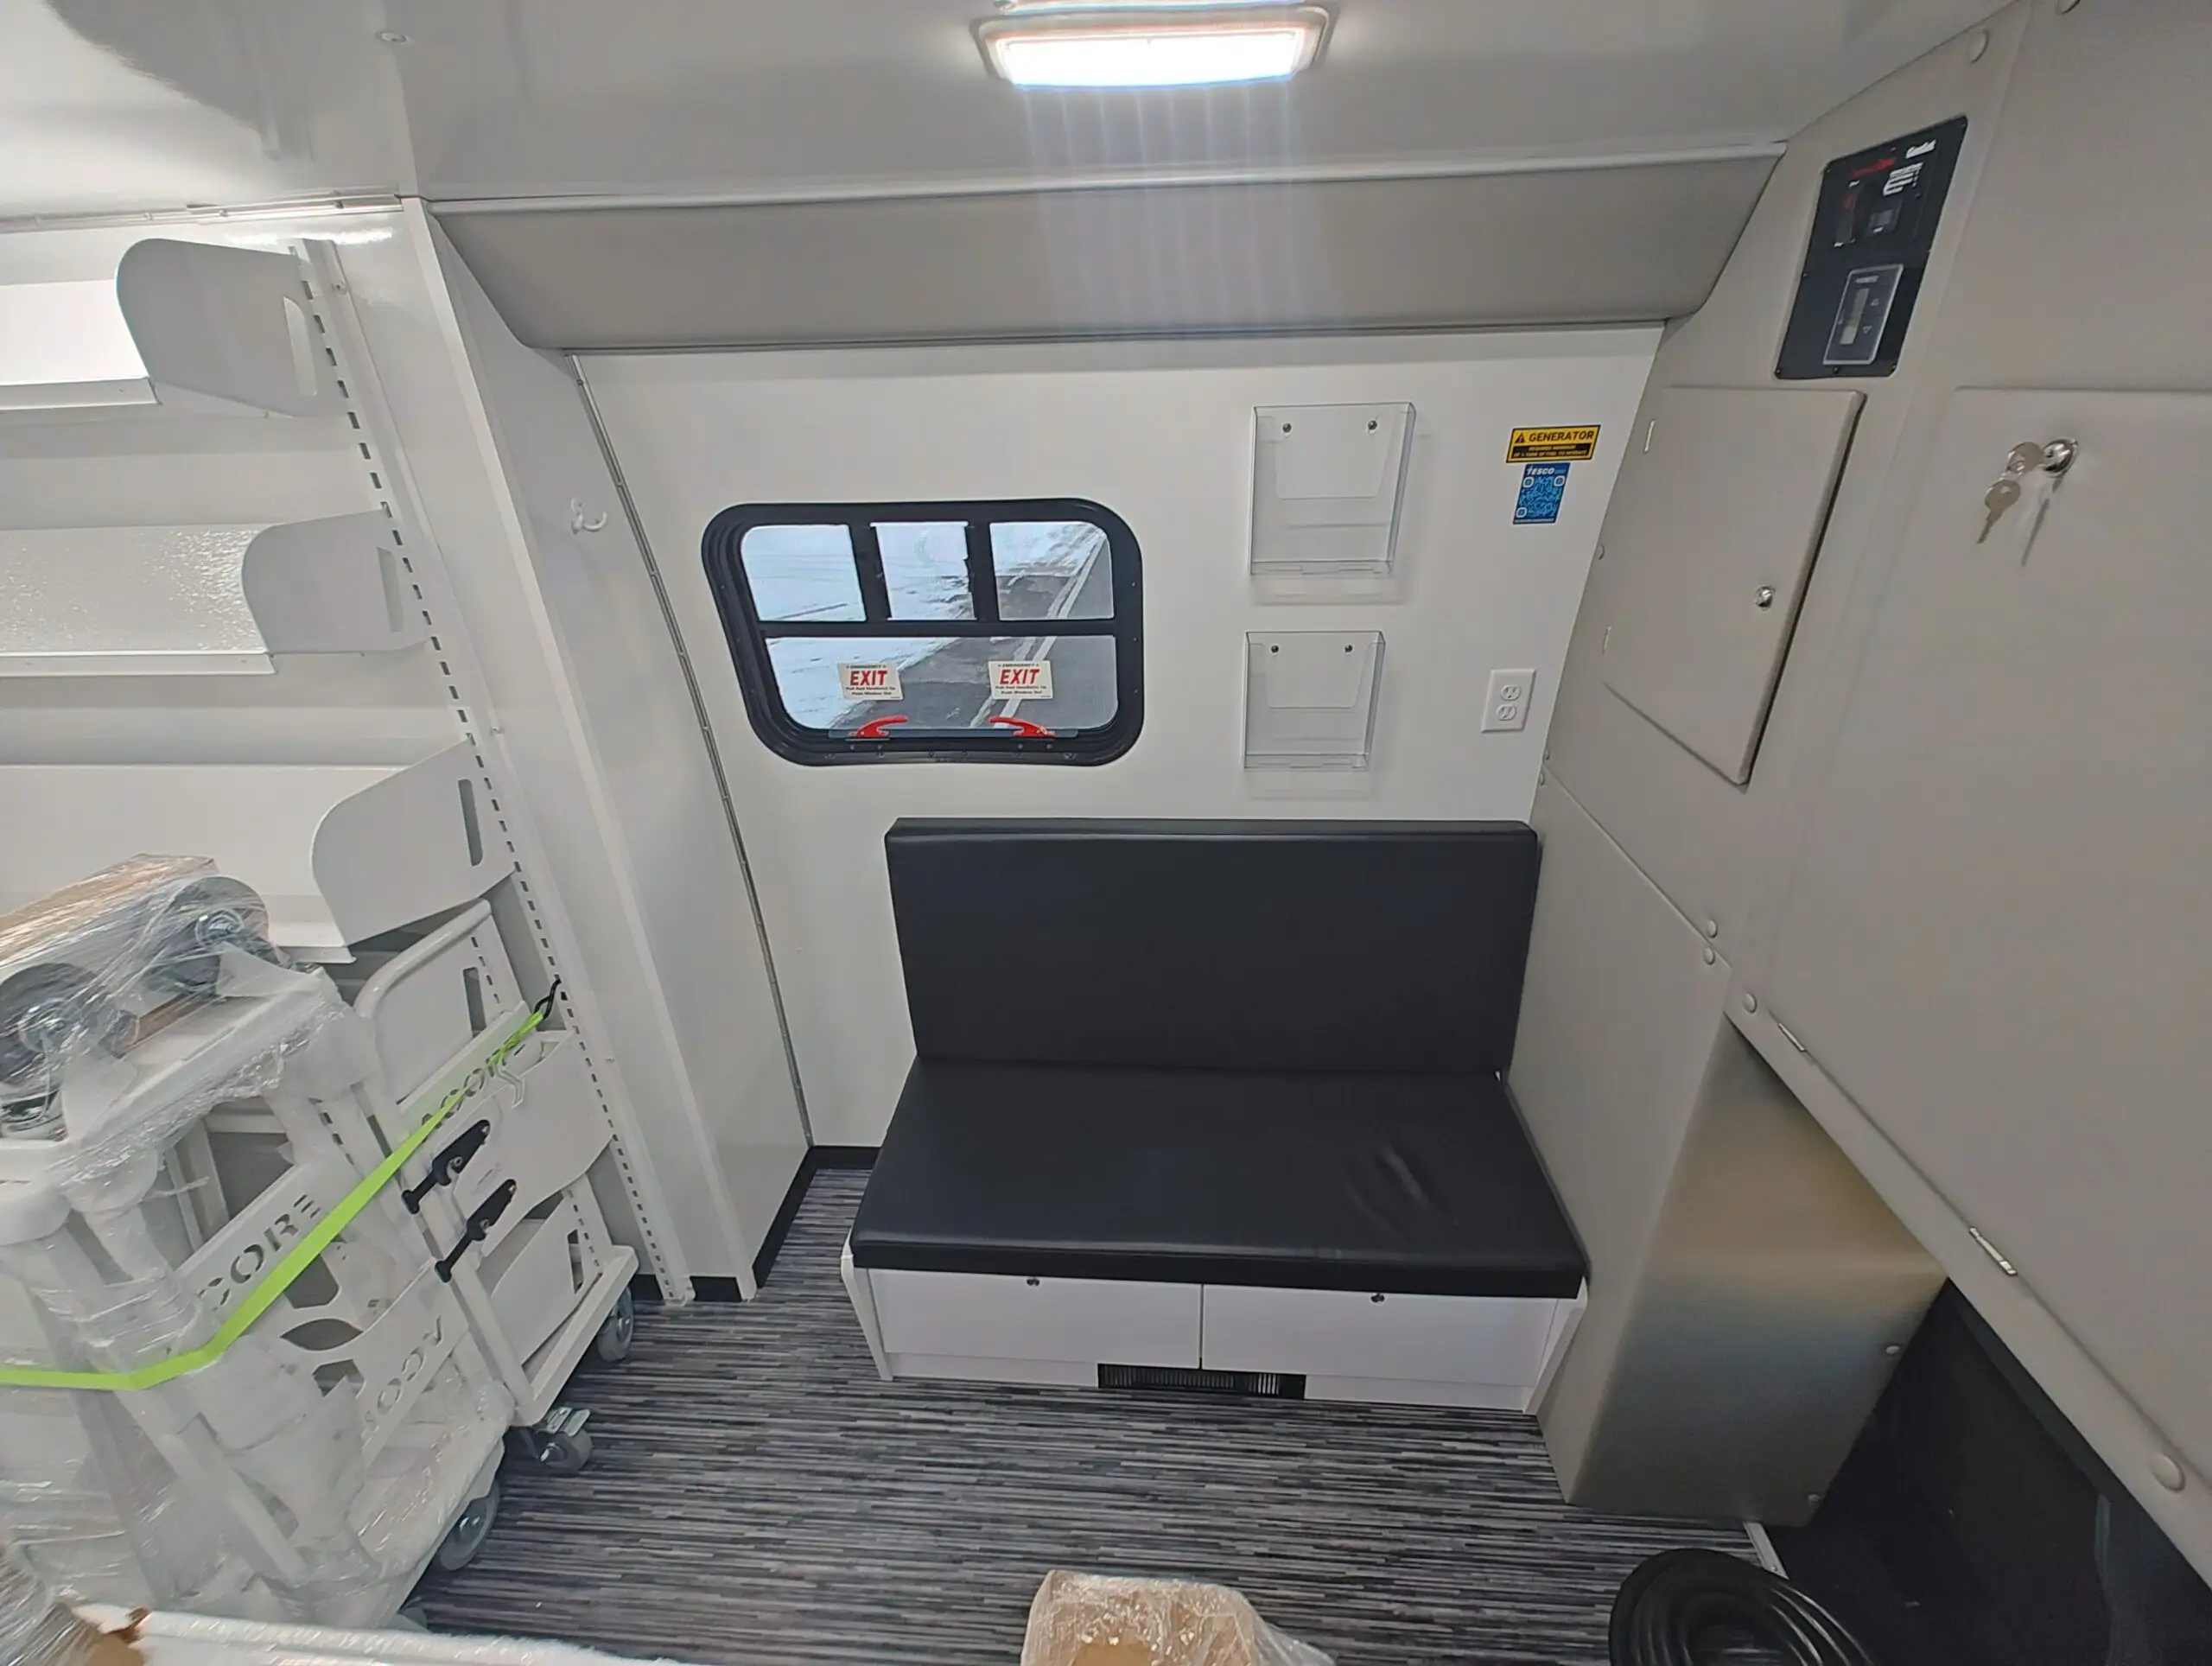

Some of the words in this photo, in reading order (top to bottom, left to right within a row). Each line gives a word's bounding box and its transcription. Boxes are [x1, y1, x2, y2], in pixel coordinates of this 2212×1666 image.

[1529, 430, 1594, 442] GENERATOR
[1526, 466, 1555, 475] TESCO
[850, 671, 887, 686] EXIT
[1000, 669, 1040, 684] EXIT
